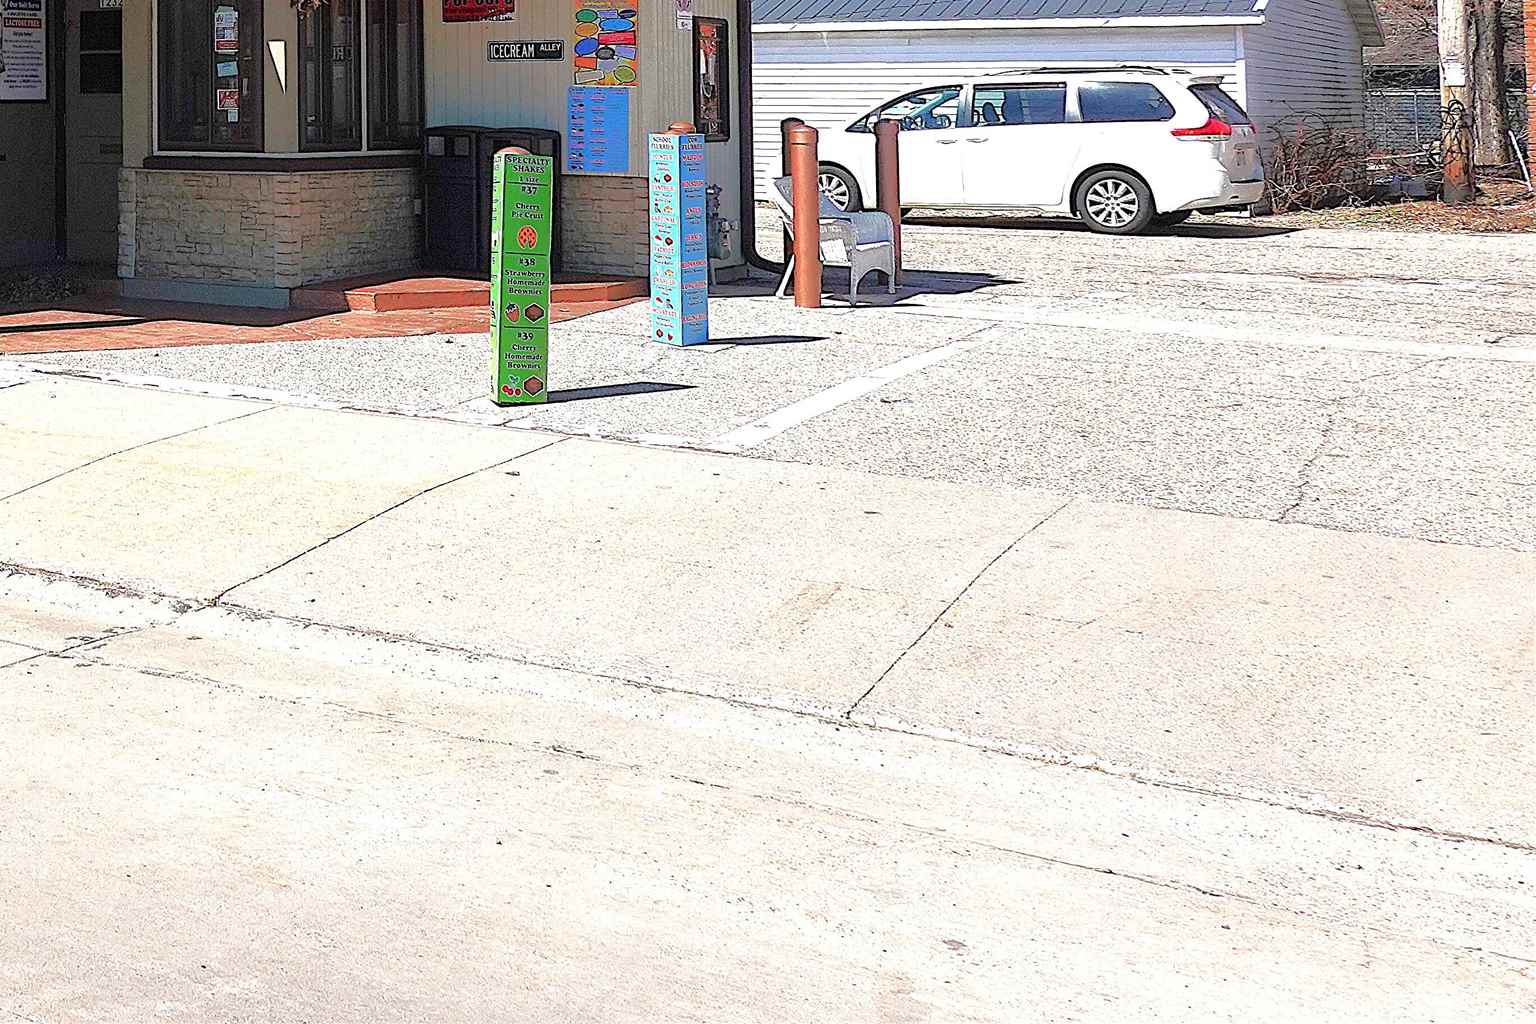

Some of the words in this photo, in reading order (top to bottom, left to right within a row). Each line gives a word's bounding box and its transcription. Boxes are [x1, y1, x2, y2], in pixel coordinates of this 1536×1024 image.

[490, 43, 535, 59] ICECREAM
[539, 43, 562, 52] ALLEY
[505, 156, 549, 166] SPECIALTY
[512, 165, 545, 174] SHAKES
[521, 185, 538, 195] #37
[515, 202, 540, 211] Cherry
[511, 210, 524, 218] Pie
[525, 211, 544, 219] Crust
[519, 257, 536, 267] #38
[505, 269, 545, 279] Strawberry
[506, 278, 545, 287] Homemade
[508, 287, 543, 295] Brownies
[517, 331, 534, 341] #39
[512, 343, 536, 352] Cherry
[505, 352, 543, 361] Homemade
[507, 361, 541, 369] Brownies
